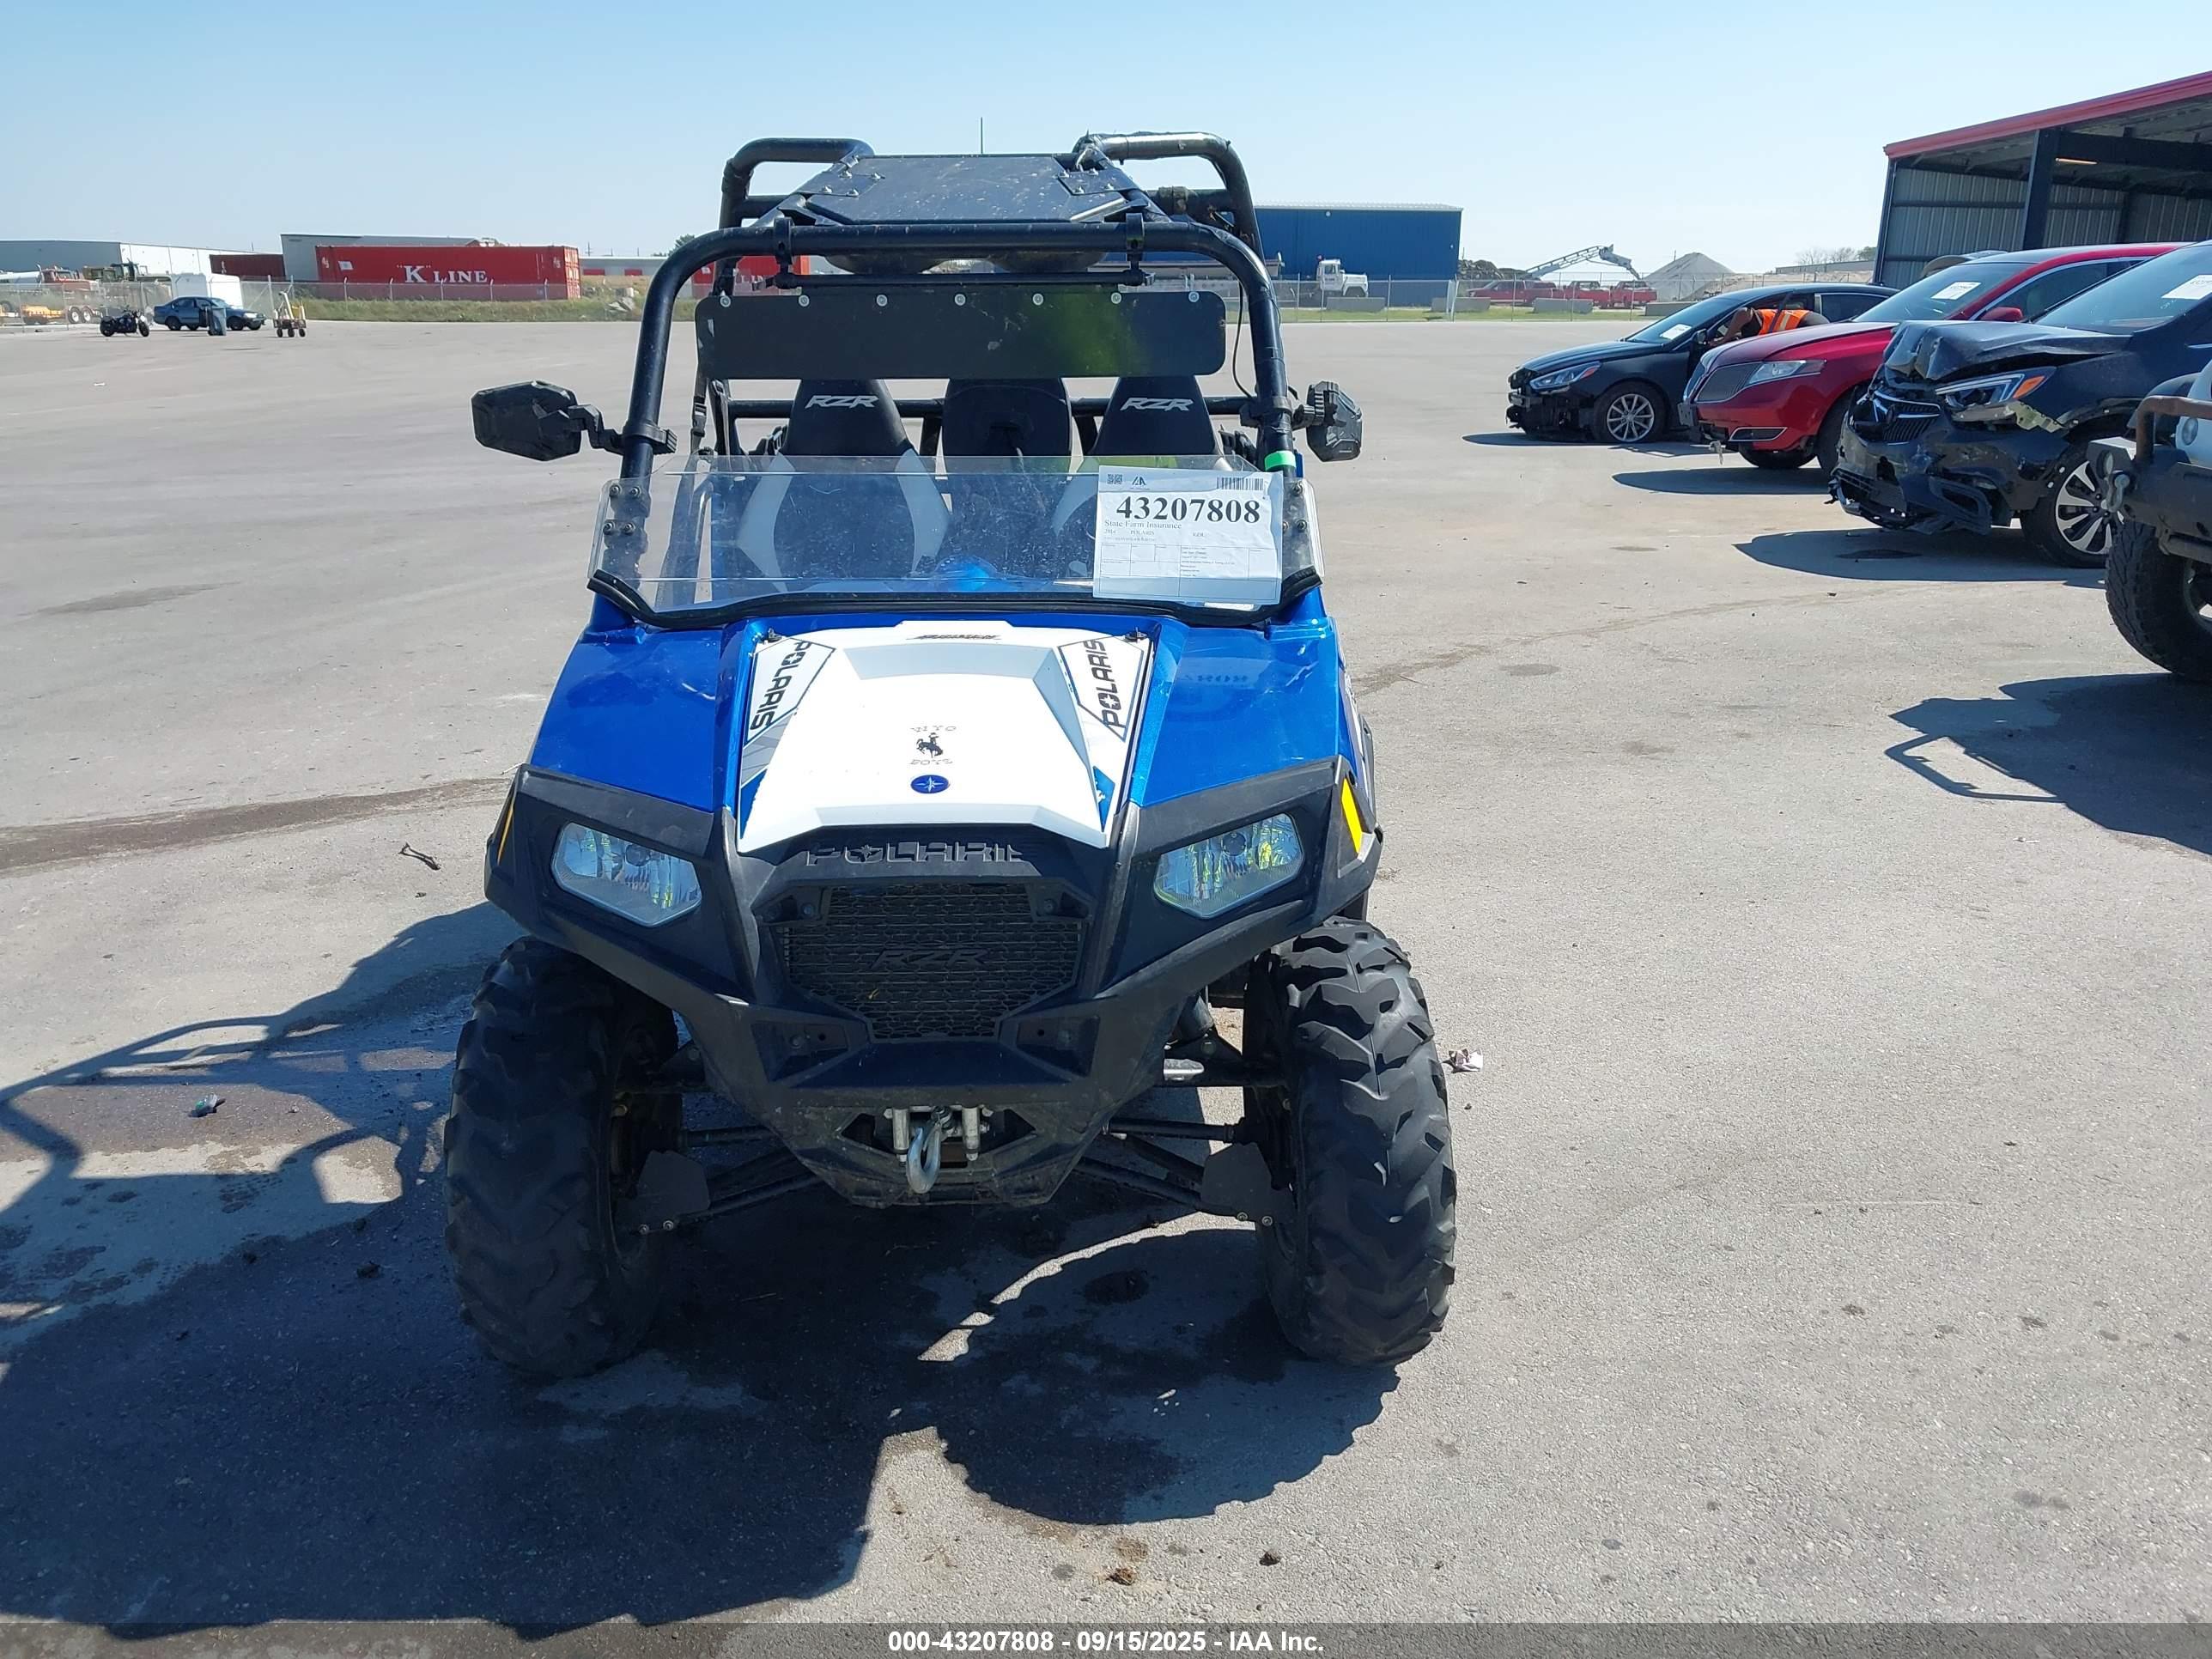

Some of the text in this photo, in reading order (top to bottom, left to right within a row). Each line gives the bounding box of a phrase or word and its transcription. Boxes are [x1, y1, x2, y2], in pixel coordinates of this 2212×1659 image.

[433, 270, 489, 283] LINE
[805, 395, 879, 409] RZR
[1120, 398, 1194, 411] RZR
[1116, 495, 1261, 524] 43207808
[750, 641, 812, 730] POLARIS
[1083, 639, 1127, 729] POLARIS
[869, 947, 989, 969] RZR
